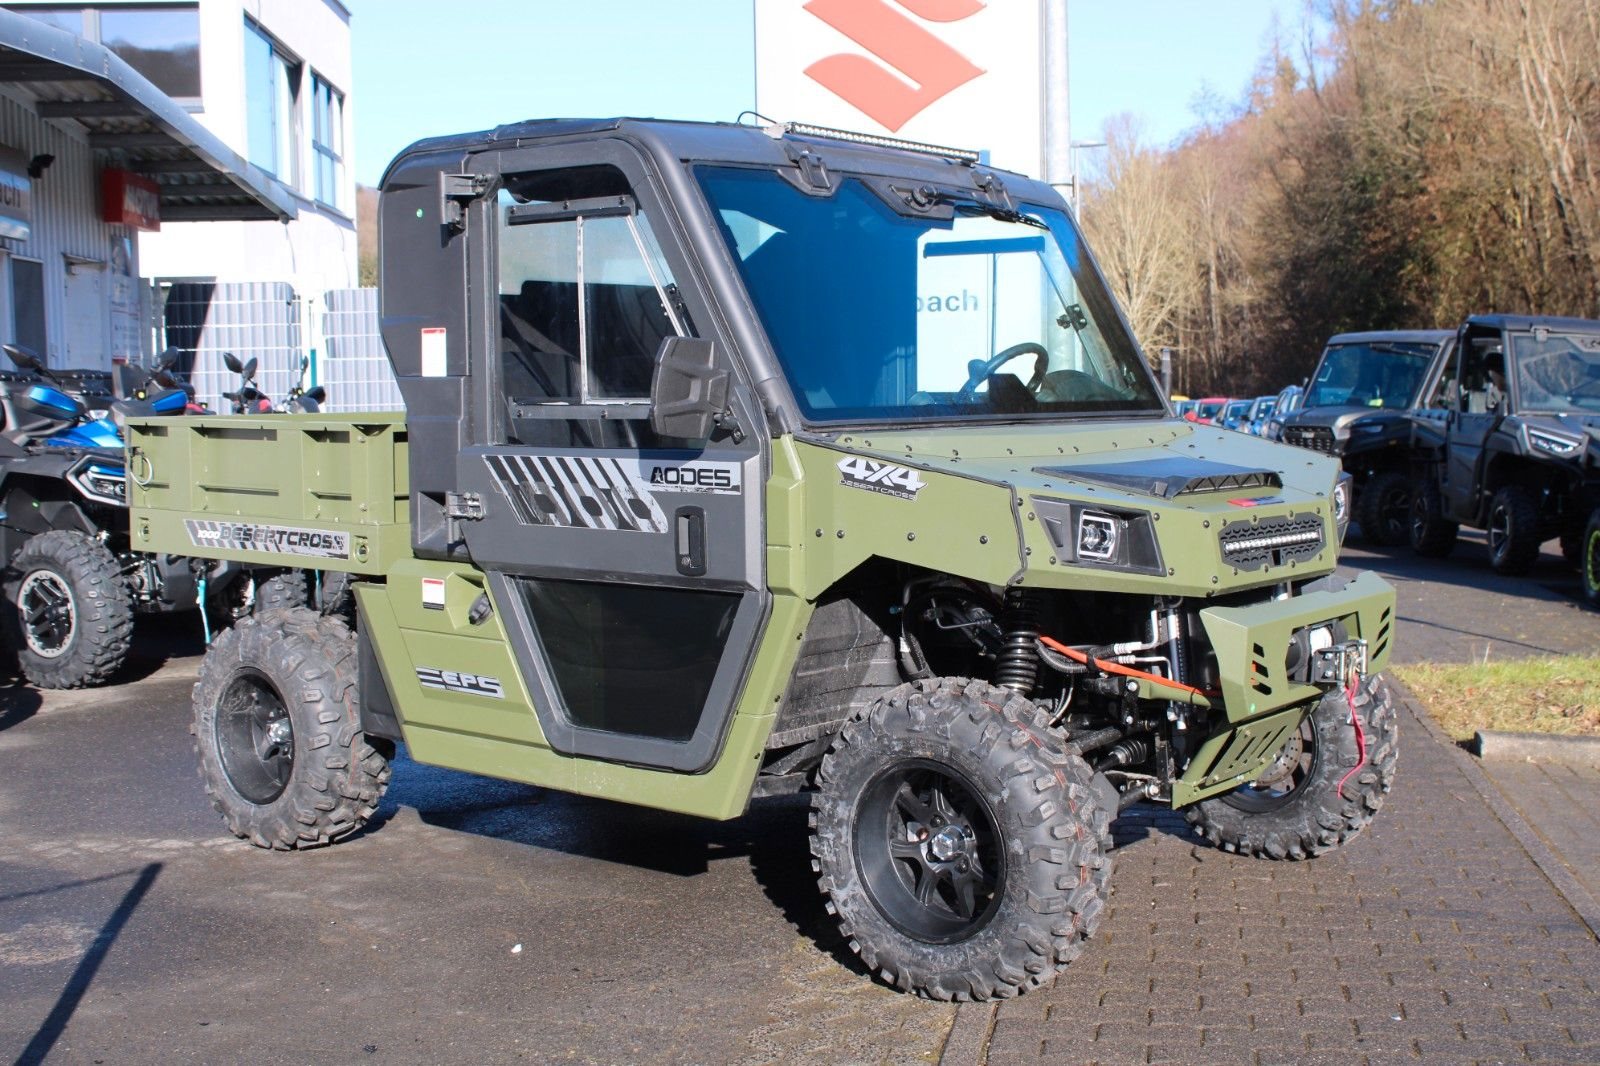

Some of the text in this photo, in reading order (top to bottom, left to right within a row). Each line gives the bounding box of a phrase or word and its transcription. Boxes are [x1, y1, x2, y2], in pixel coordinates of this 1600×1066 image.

[650, 466, 731, 487] AODES
[220, 525, 345, 551] DESERTCROSS
[438, 670, 506, 700] EPS
